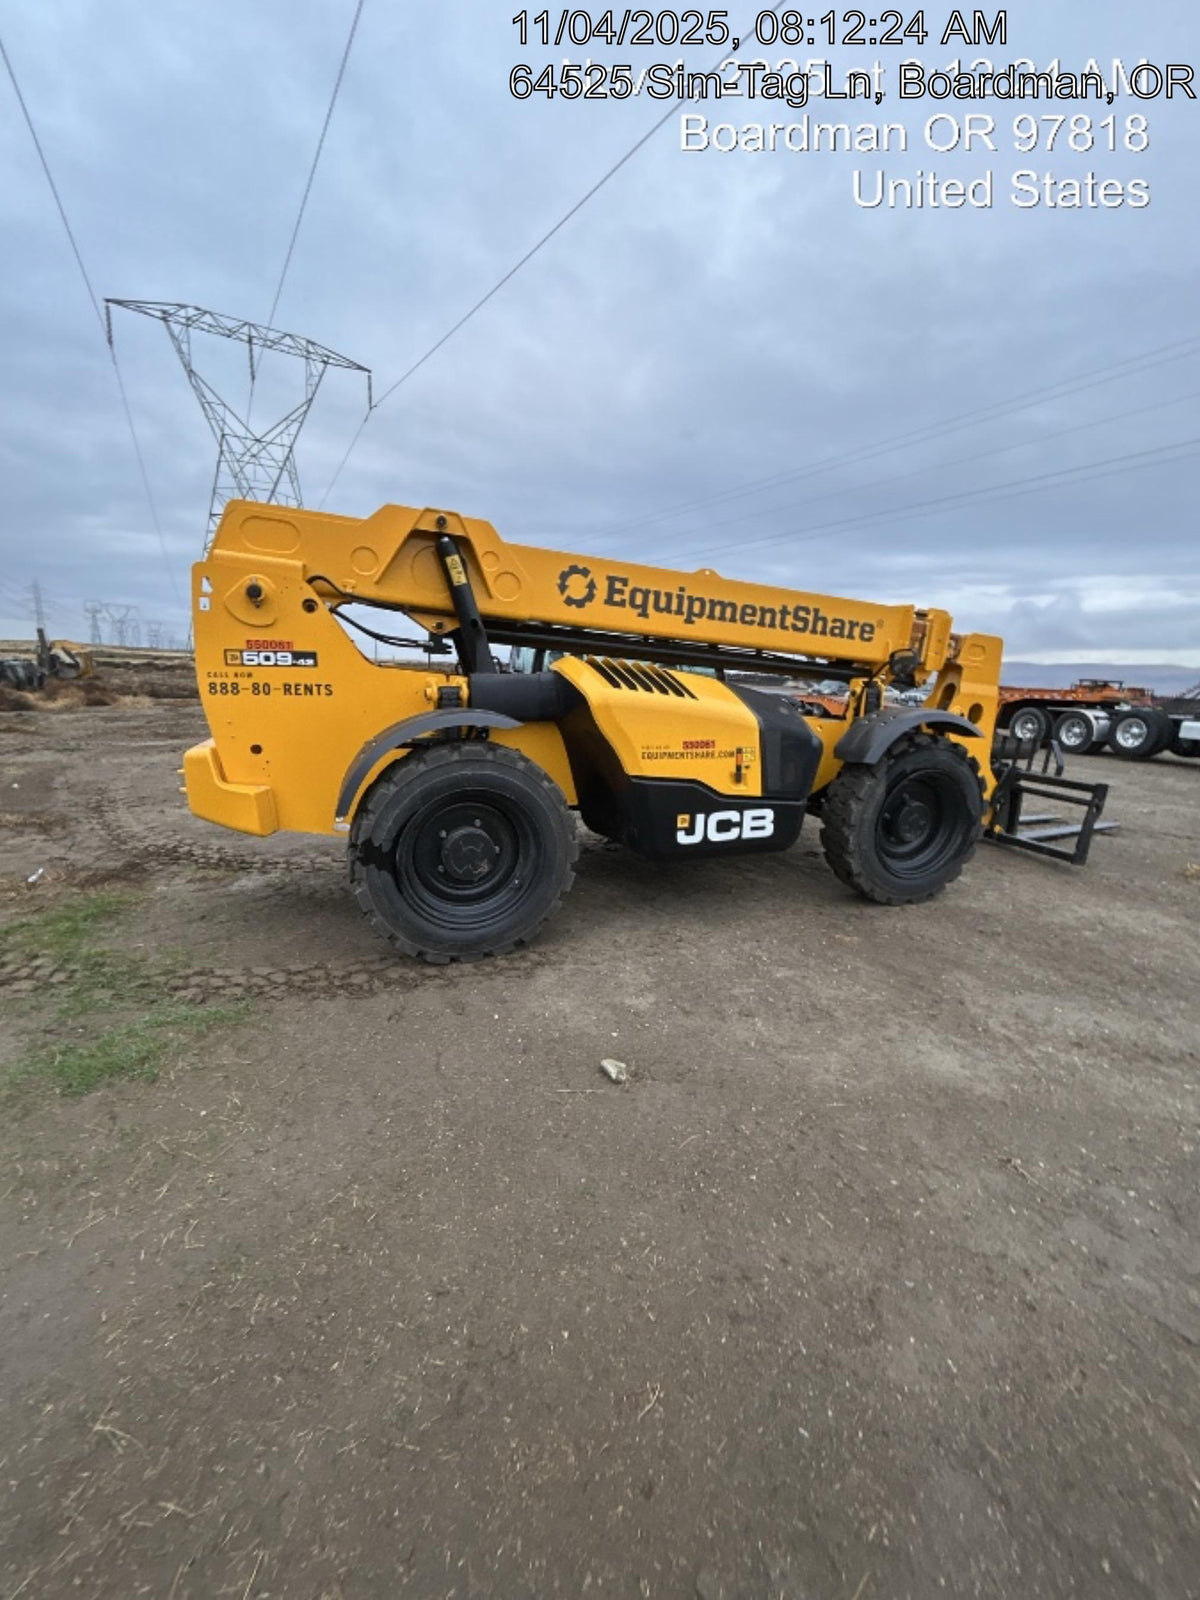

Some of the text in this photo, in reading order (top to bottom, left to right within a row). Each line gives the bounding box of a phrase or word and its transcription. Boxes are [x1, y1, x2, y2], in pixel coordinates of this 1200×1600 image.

[604, 575, 877, 643] EquipmentShare
[208, 682, 333, 696] 888-80-RENTS
[677, 808, 775, 845] JCB
